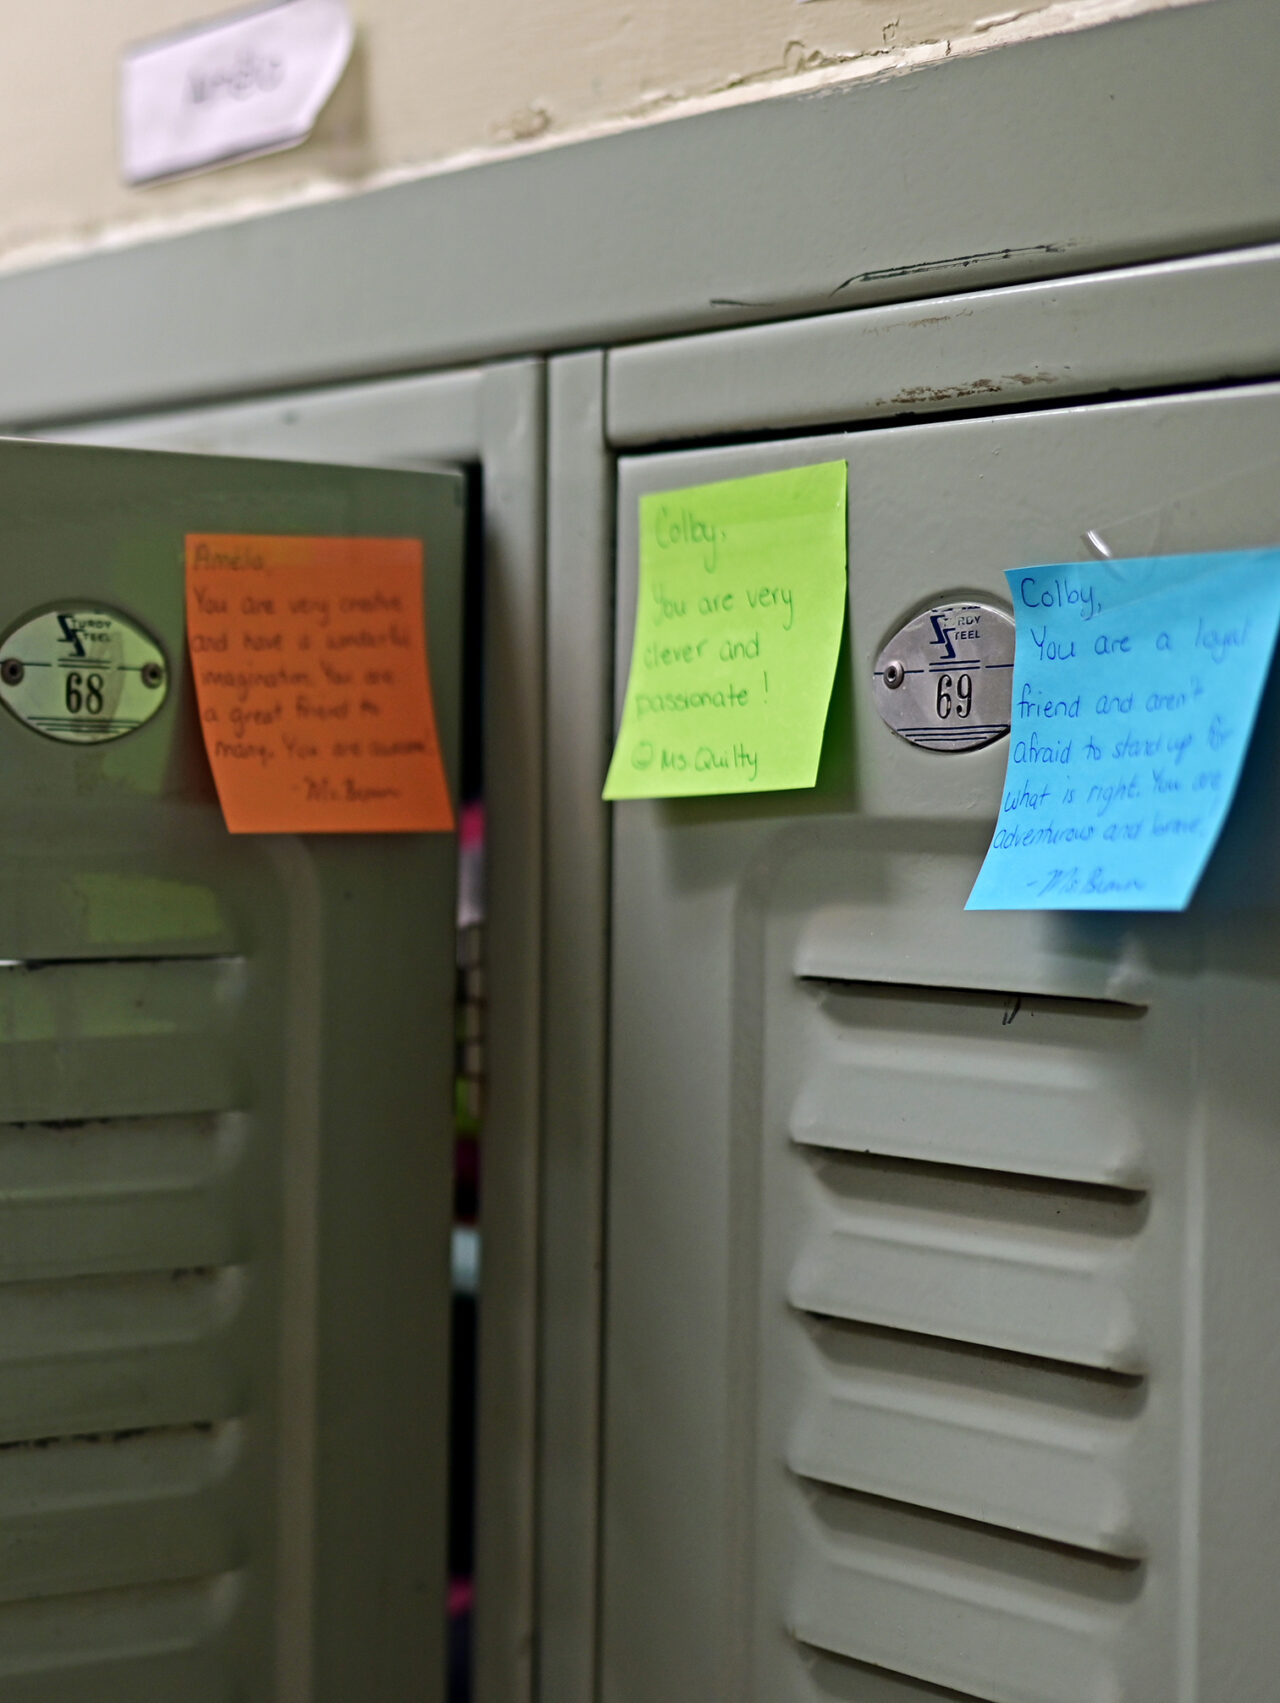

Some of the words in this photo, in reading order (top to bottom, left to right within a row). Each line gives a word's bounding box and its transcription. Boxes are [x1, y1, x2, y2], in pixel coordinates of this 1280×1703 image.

[652, 583, 687, 627] You
[698, 592, 734, 616] are
[746, 585, 795, 631] very
[1019, 577, 1103, 623] Colby,
[642, 639, 709, 670] clever
[718, 631, 761, 663] and
[1029, 624, 1077, 662] You
[1093, 630, 1133, 654] are
[1154, 630, 1174, 652] a
[65, 671, 104, 715] 68
[935, 673, 973, 720] 69
[1016, 682, 1080, 719] friend
[1095, 691, 1134, 715] and
[1085, 734, 1103, 761] to
[1003, 779, 1052, 814] what
[1062, 774, 1076, 806] is
